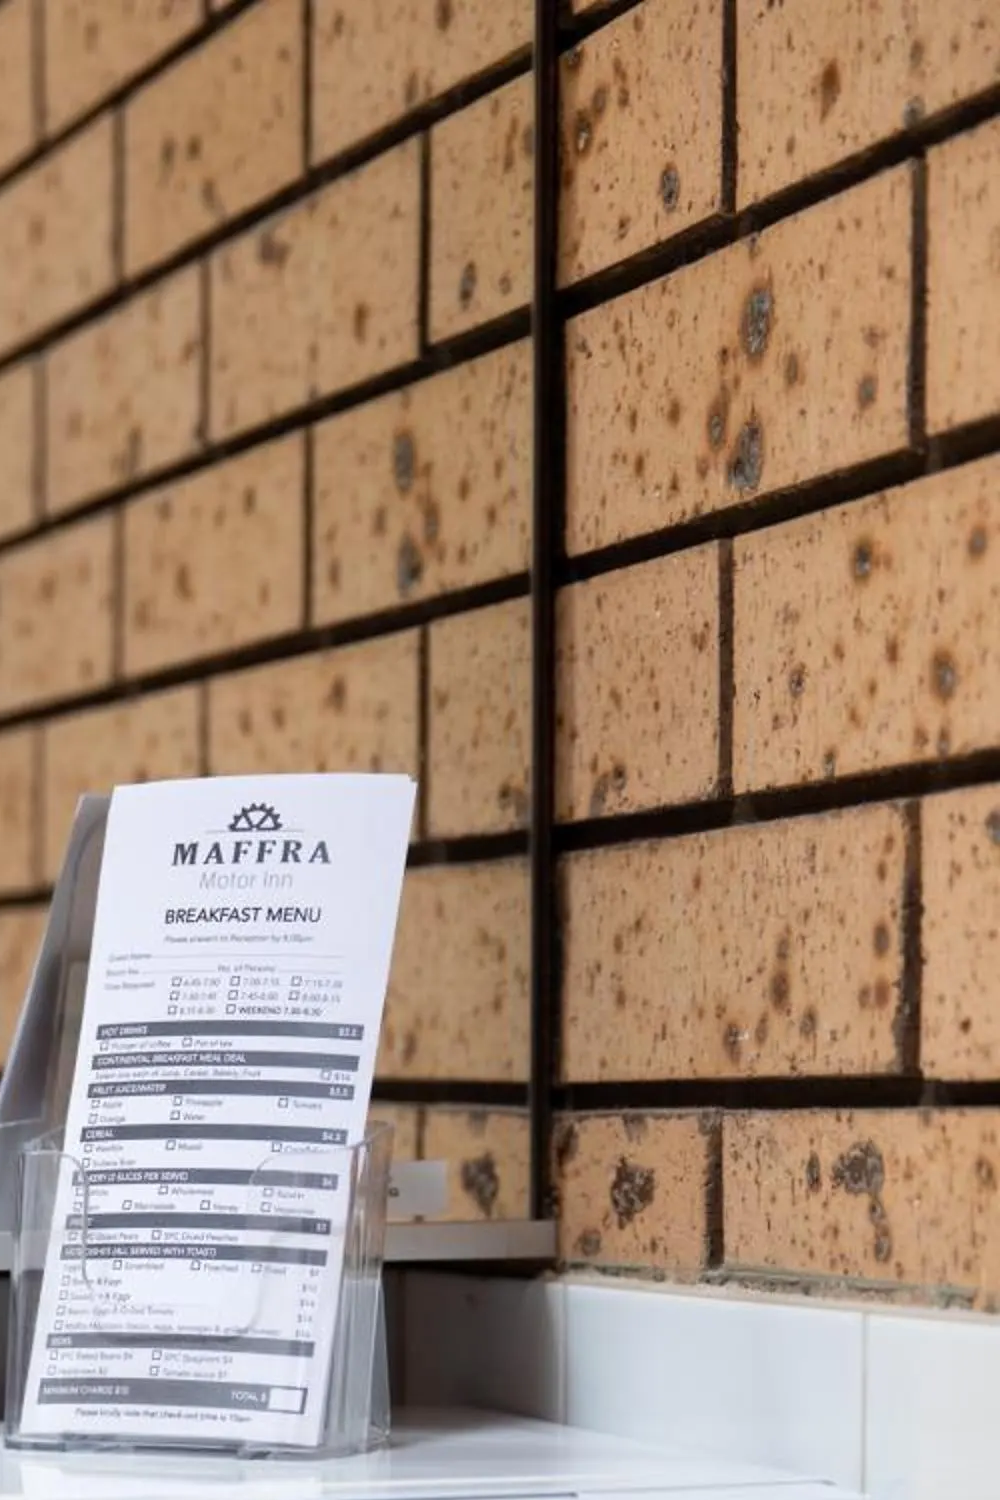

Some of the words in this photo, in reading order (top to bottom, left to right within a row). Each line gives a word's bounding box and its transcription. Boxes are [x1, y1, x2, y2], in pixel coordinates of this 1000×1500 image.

[171, 839, 332, 866] MAFFRA
[199, 871, 257, 890] Motor
[263, 870, 293, 889] Inn
[164, 907, 262, 924] BREAKFAST
[266, 907, 322, 923] MENU
[85, 1129, 114, 1140] CEREAL
[77, 1173, 107, 1184] BKERY
[143, 1171, 160, 1181] PER
[163, 1247, 185, 1256] WITH
[231, 1390, 259, 1402] TOTAL
